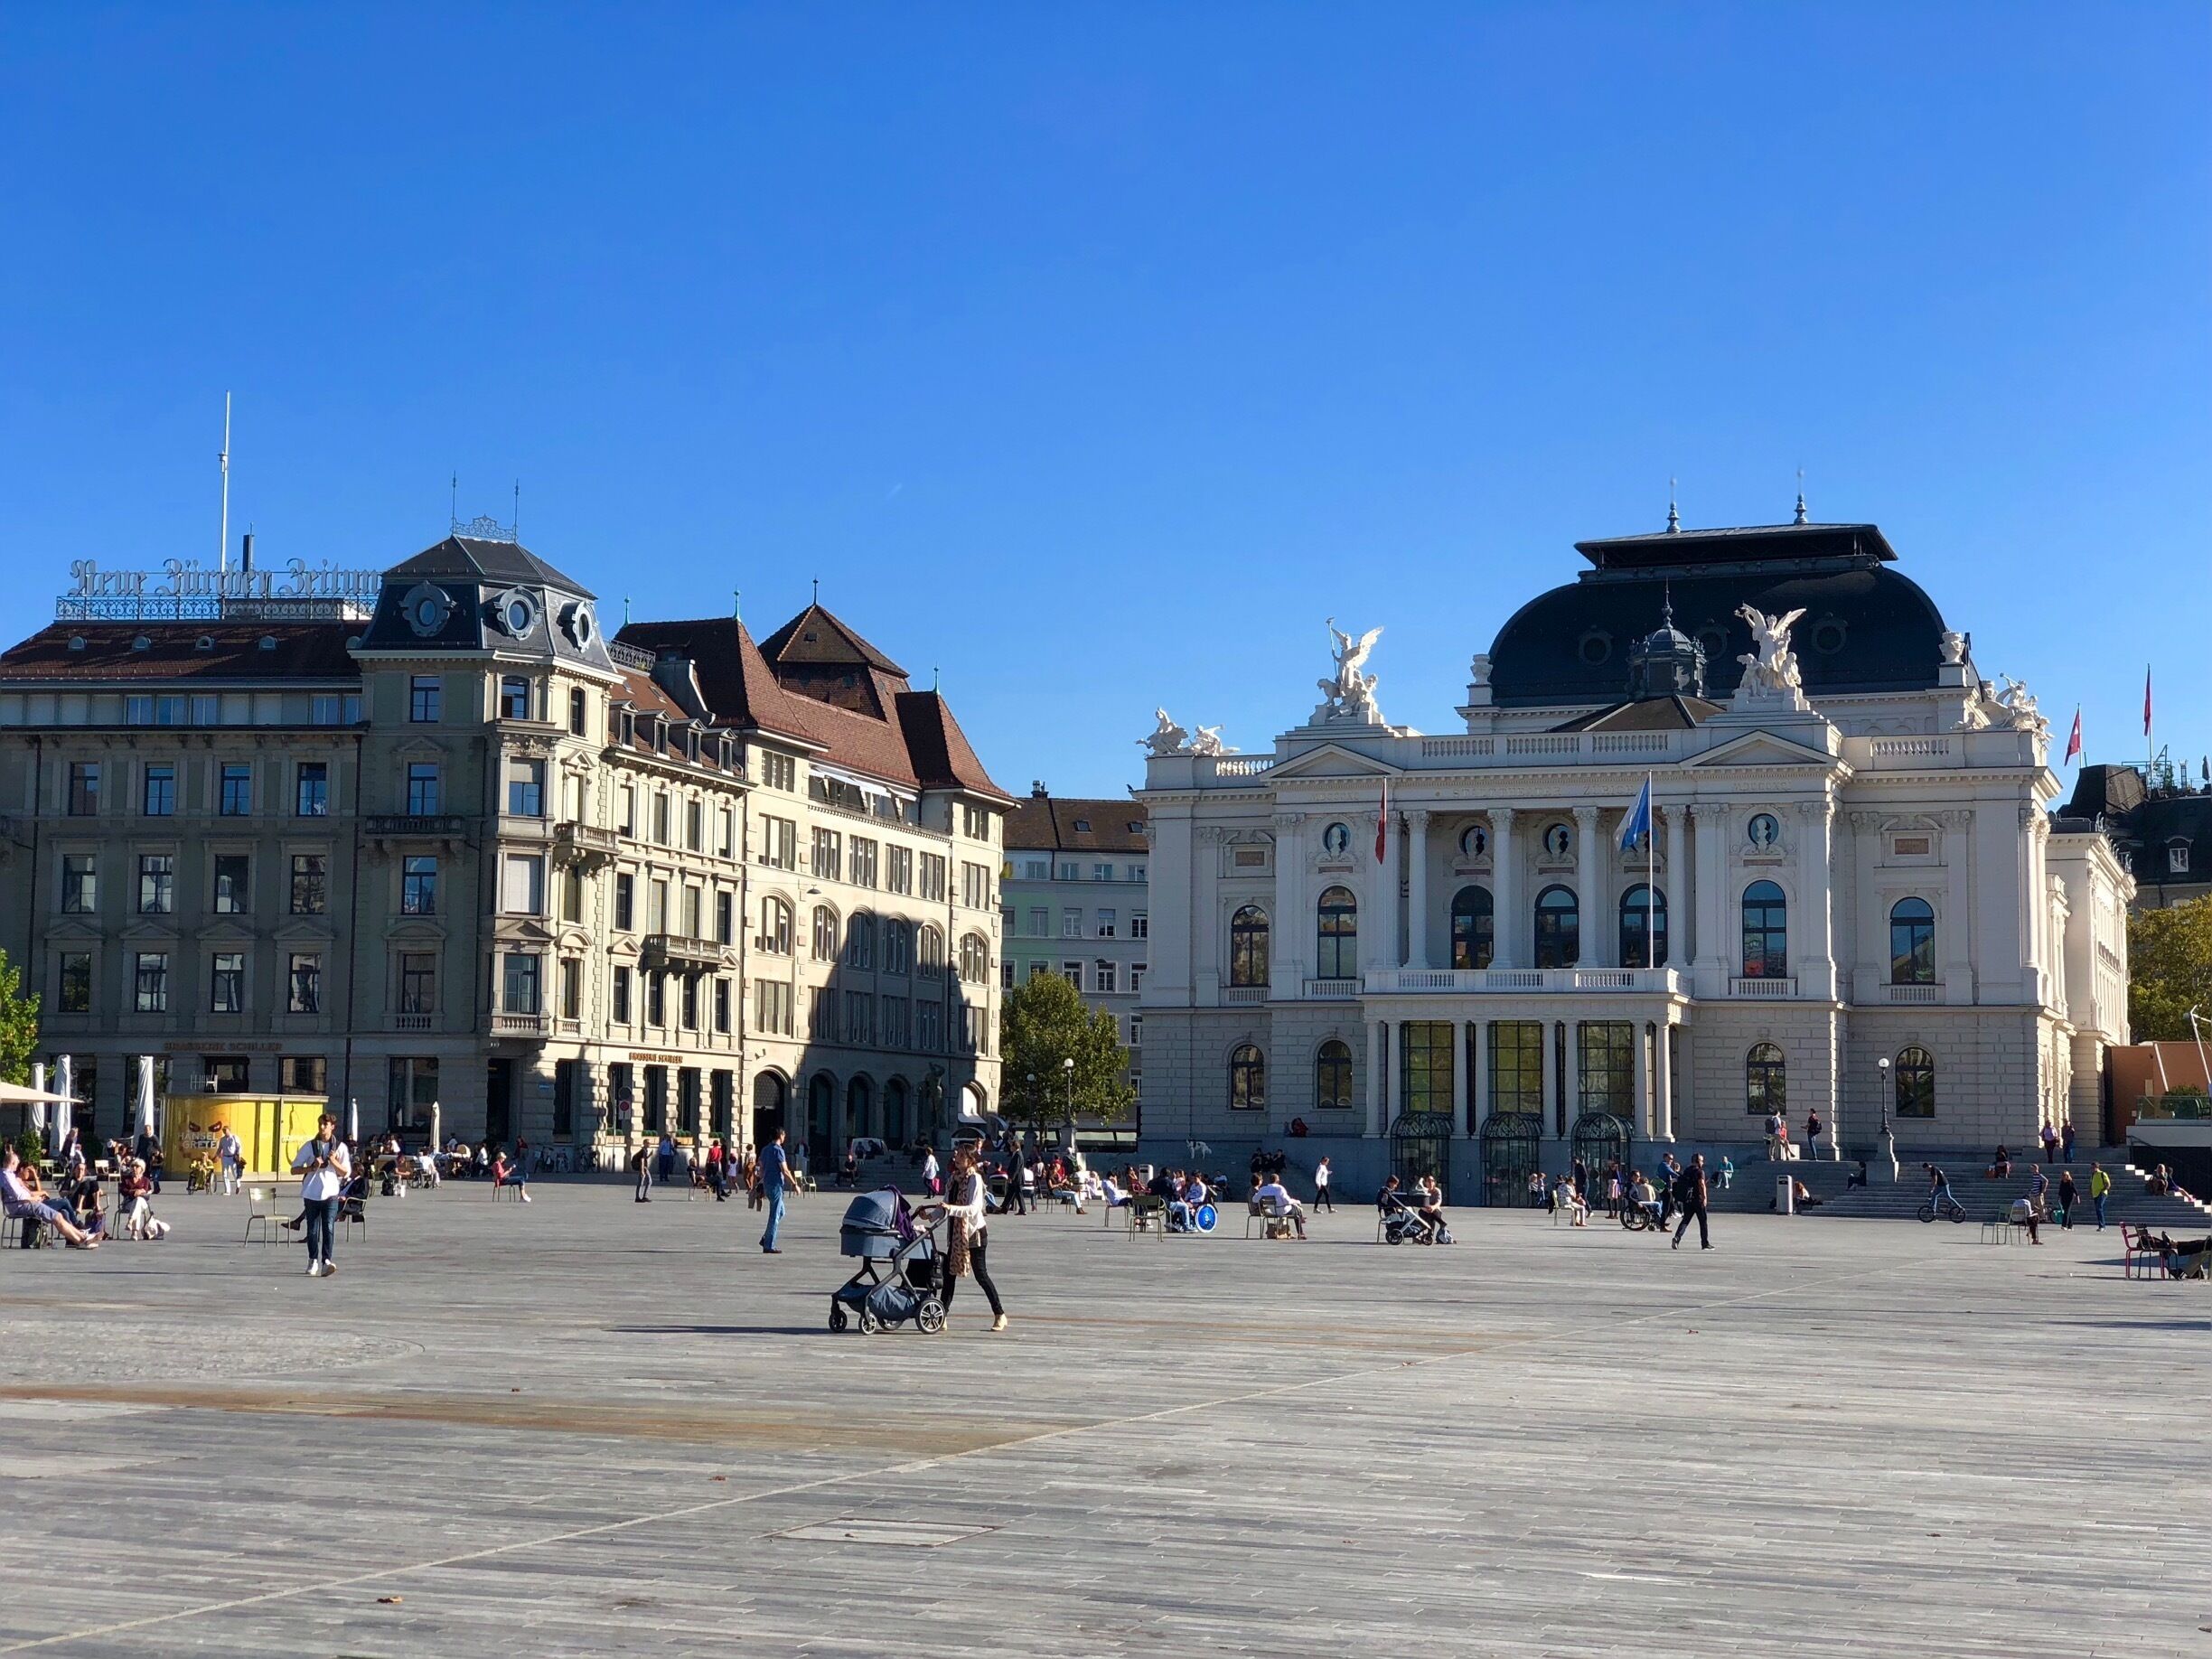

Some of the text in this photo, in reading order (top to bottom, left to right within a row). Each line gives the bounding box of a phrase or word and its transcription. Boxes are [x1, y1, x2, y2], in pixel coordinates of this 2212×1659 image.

[68, 558, 383, 596] Neue Zürcher Zeitun
